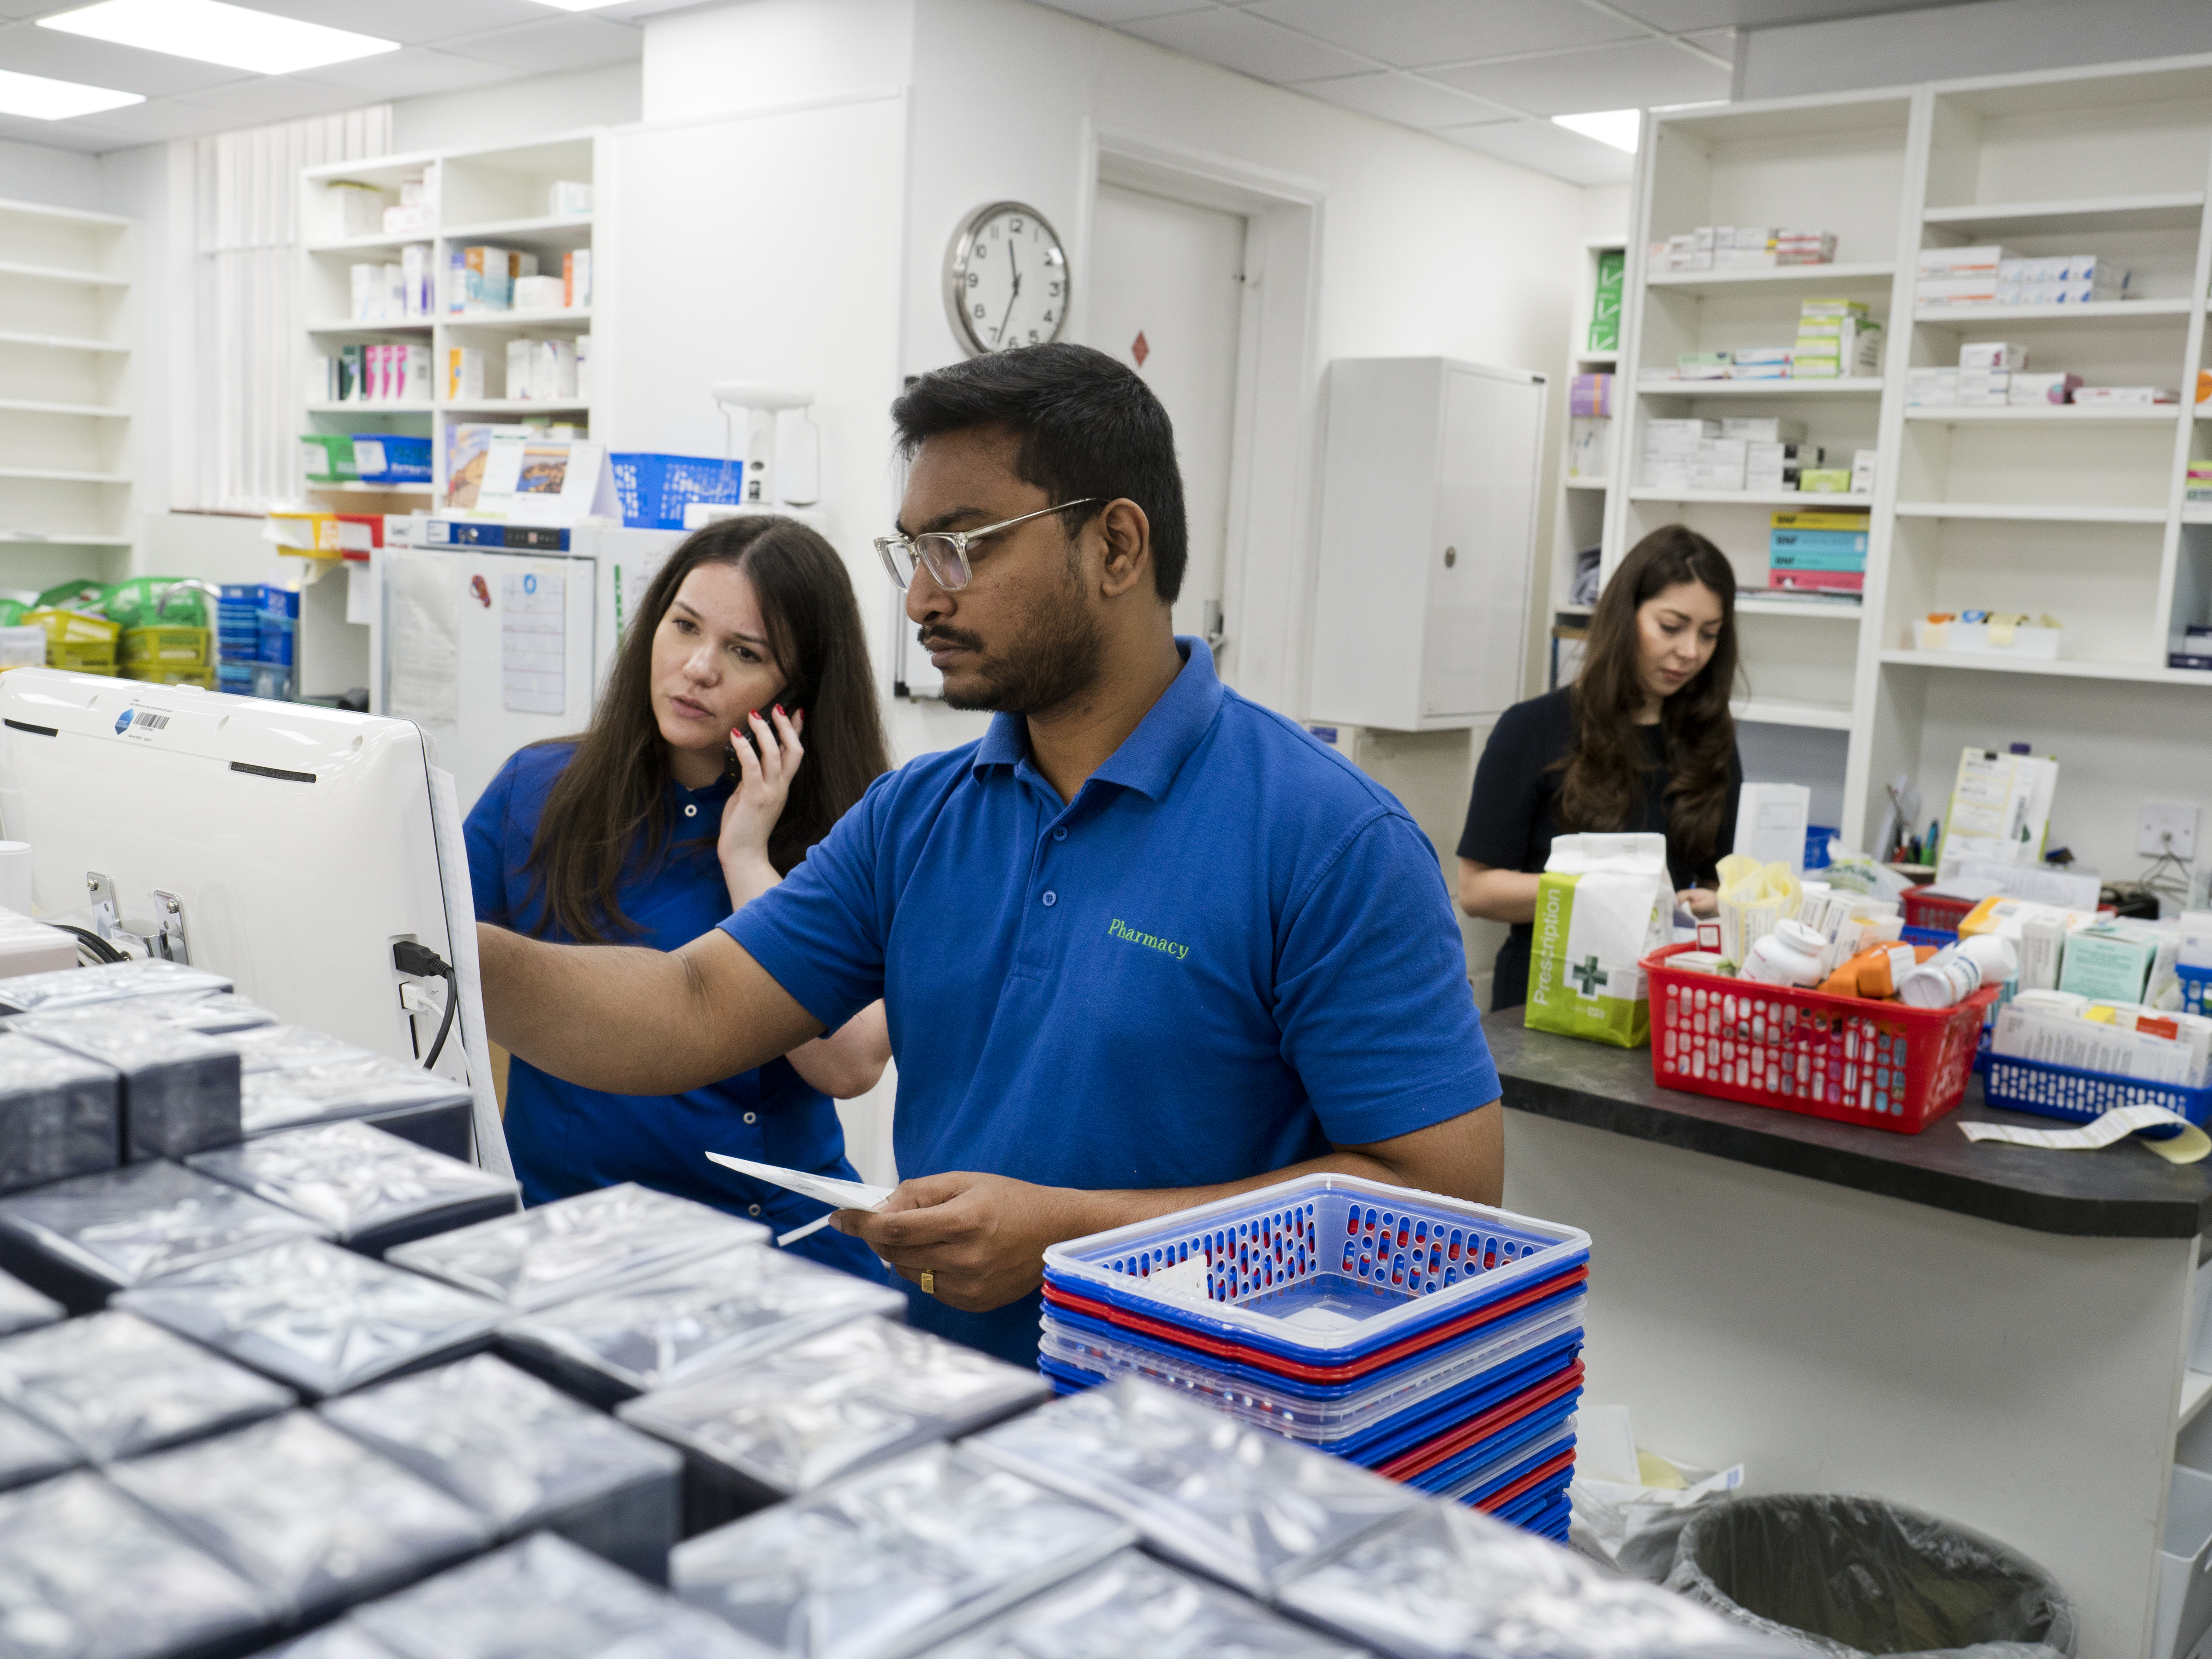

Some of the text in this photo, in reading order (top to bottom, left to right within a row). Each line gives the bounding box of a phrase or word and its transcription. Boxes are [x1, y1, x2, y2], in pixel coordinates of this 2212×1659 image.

[1009, 218, 1023, 233] 12
[968, 273, 979, 288] 9
[1050, 282, 1060, 297] 3
[974, 304, 985, 319] 8
[1044, 310, 1053, 323] 4
[989, 327, 998, 342] 7
[1028, 329, 1039, 343] 5
[1107, 918, 1189, 960] Pharmacy
[1534, 888, 1561, 1006] Prescription
